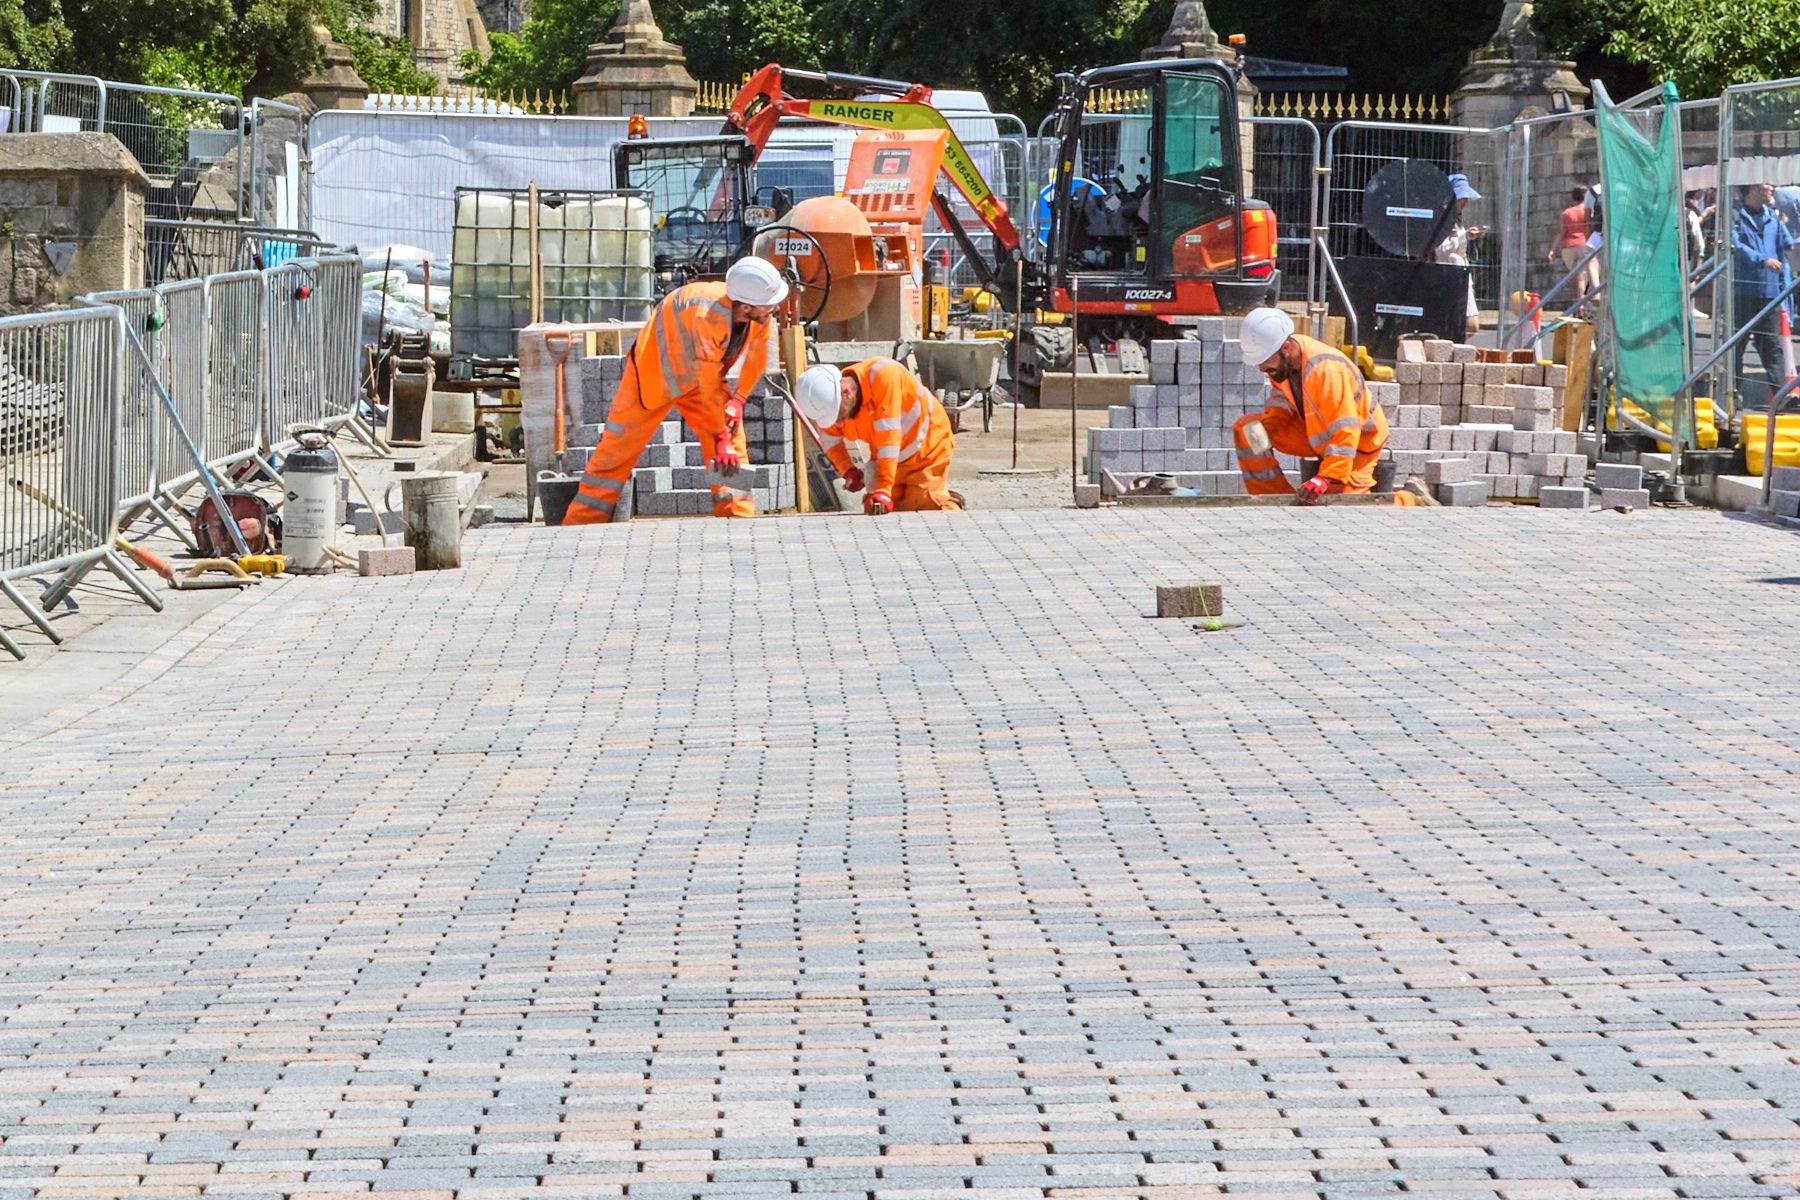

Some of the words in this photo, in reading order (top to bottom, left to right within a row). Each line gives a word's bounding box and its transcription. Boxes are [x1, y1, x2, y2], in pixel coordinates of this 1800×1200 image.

[824, 104, 894, 122] RANGER
[954, 160, 982, 196] 664200
[778, 242, 809, 251] 22024
[1125, 289, 1172, 299] KX027-4
